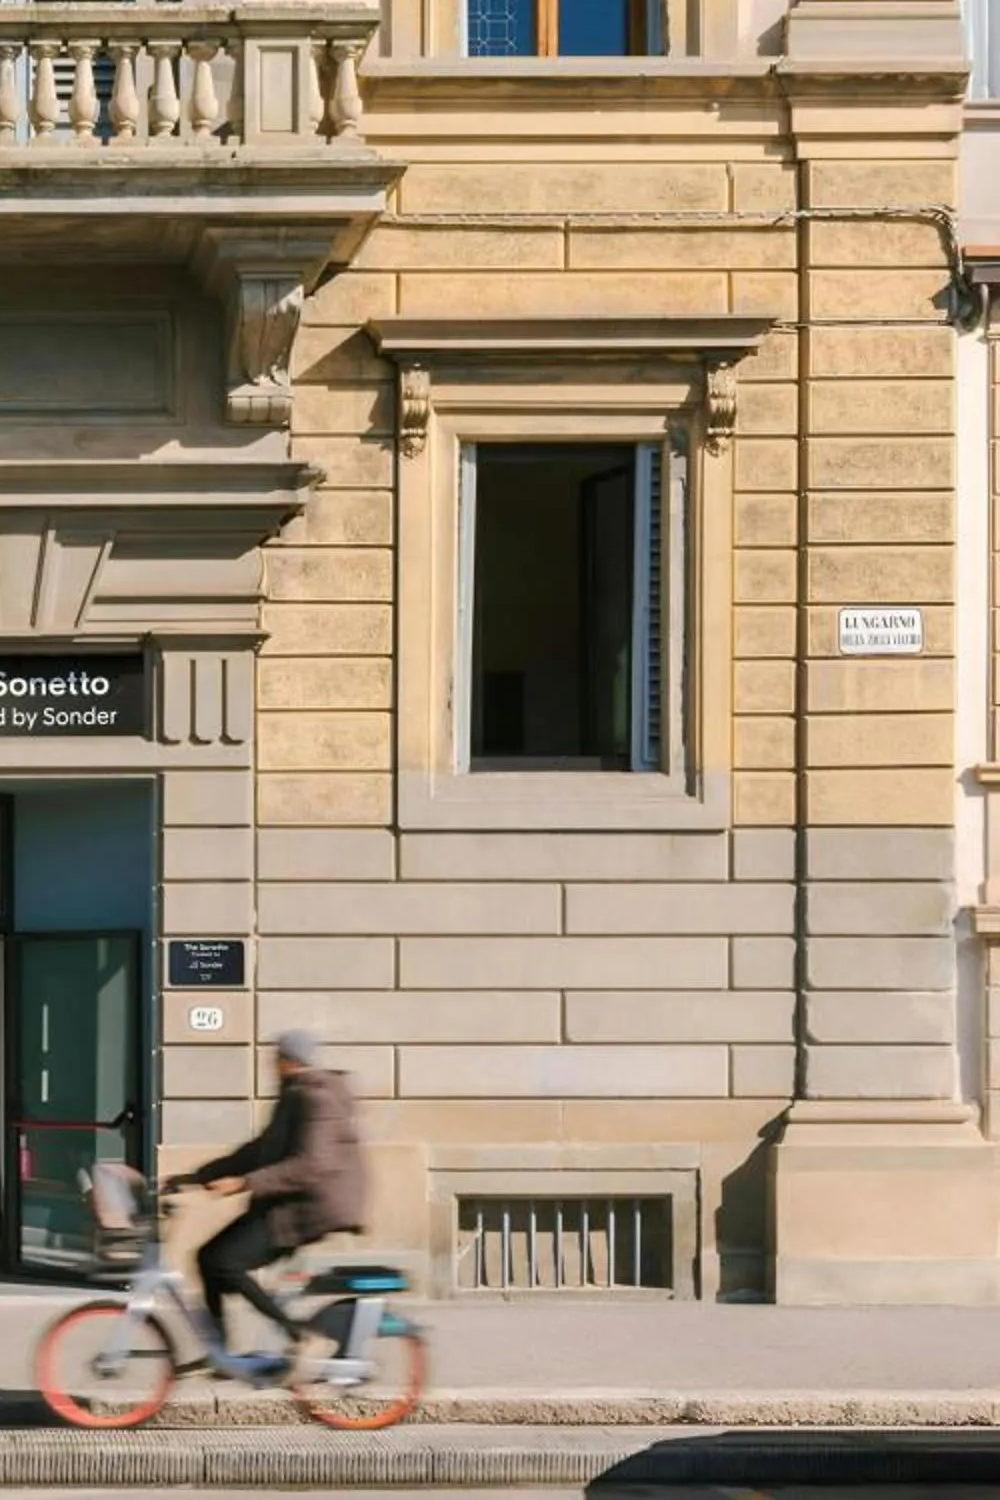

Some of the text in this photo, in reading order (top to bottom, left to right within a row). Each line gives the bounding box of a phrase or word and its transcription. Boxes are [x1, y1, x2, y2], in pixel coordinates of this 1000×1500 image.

[845, 616, 915, 629] LUNGARNO
[13, 707, 37, 730] by
[43, 706, 118, 726] Sonder
[197, 1011, 218, 1026] 26
